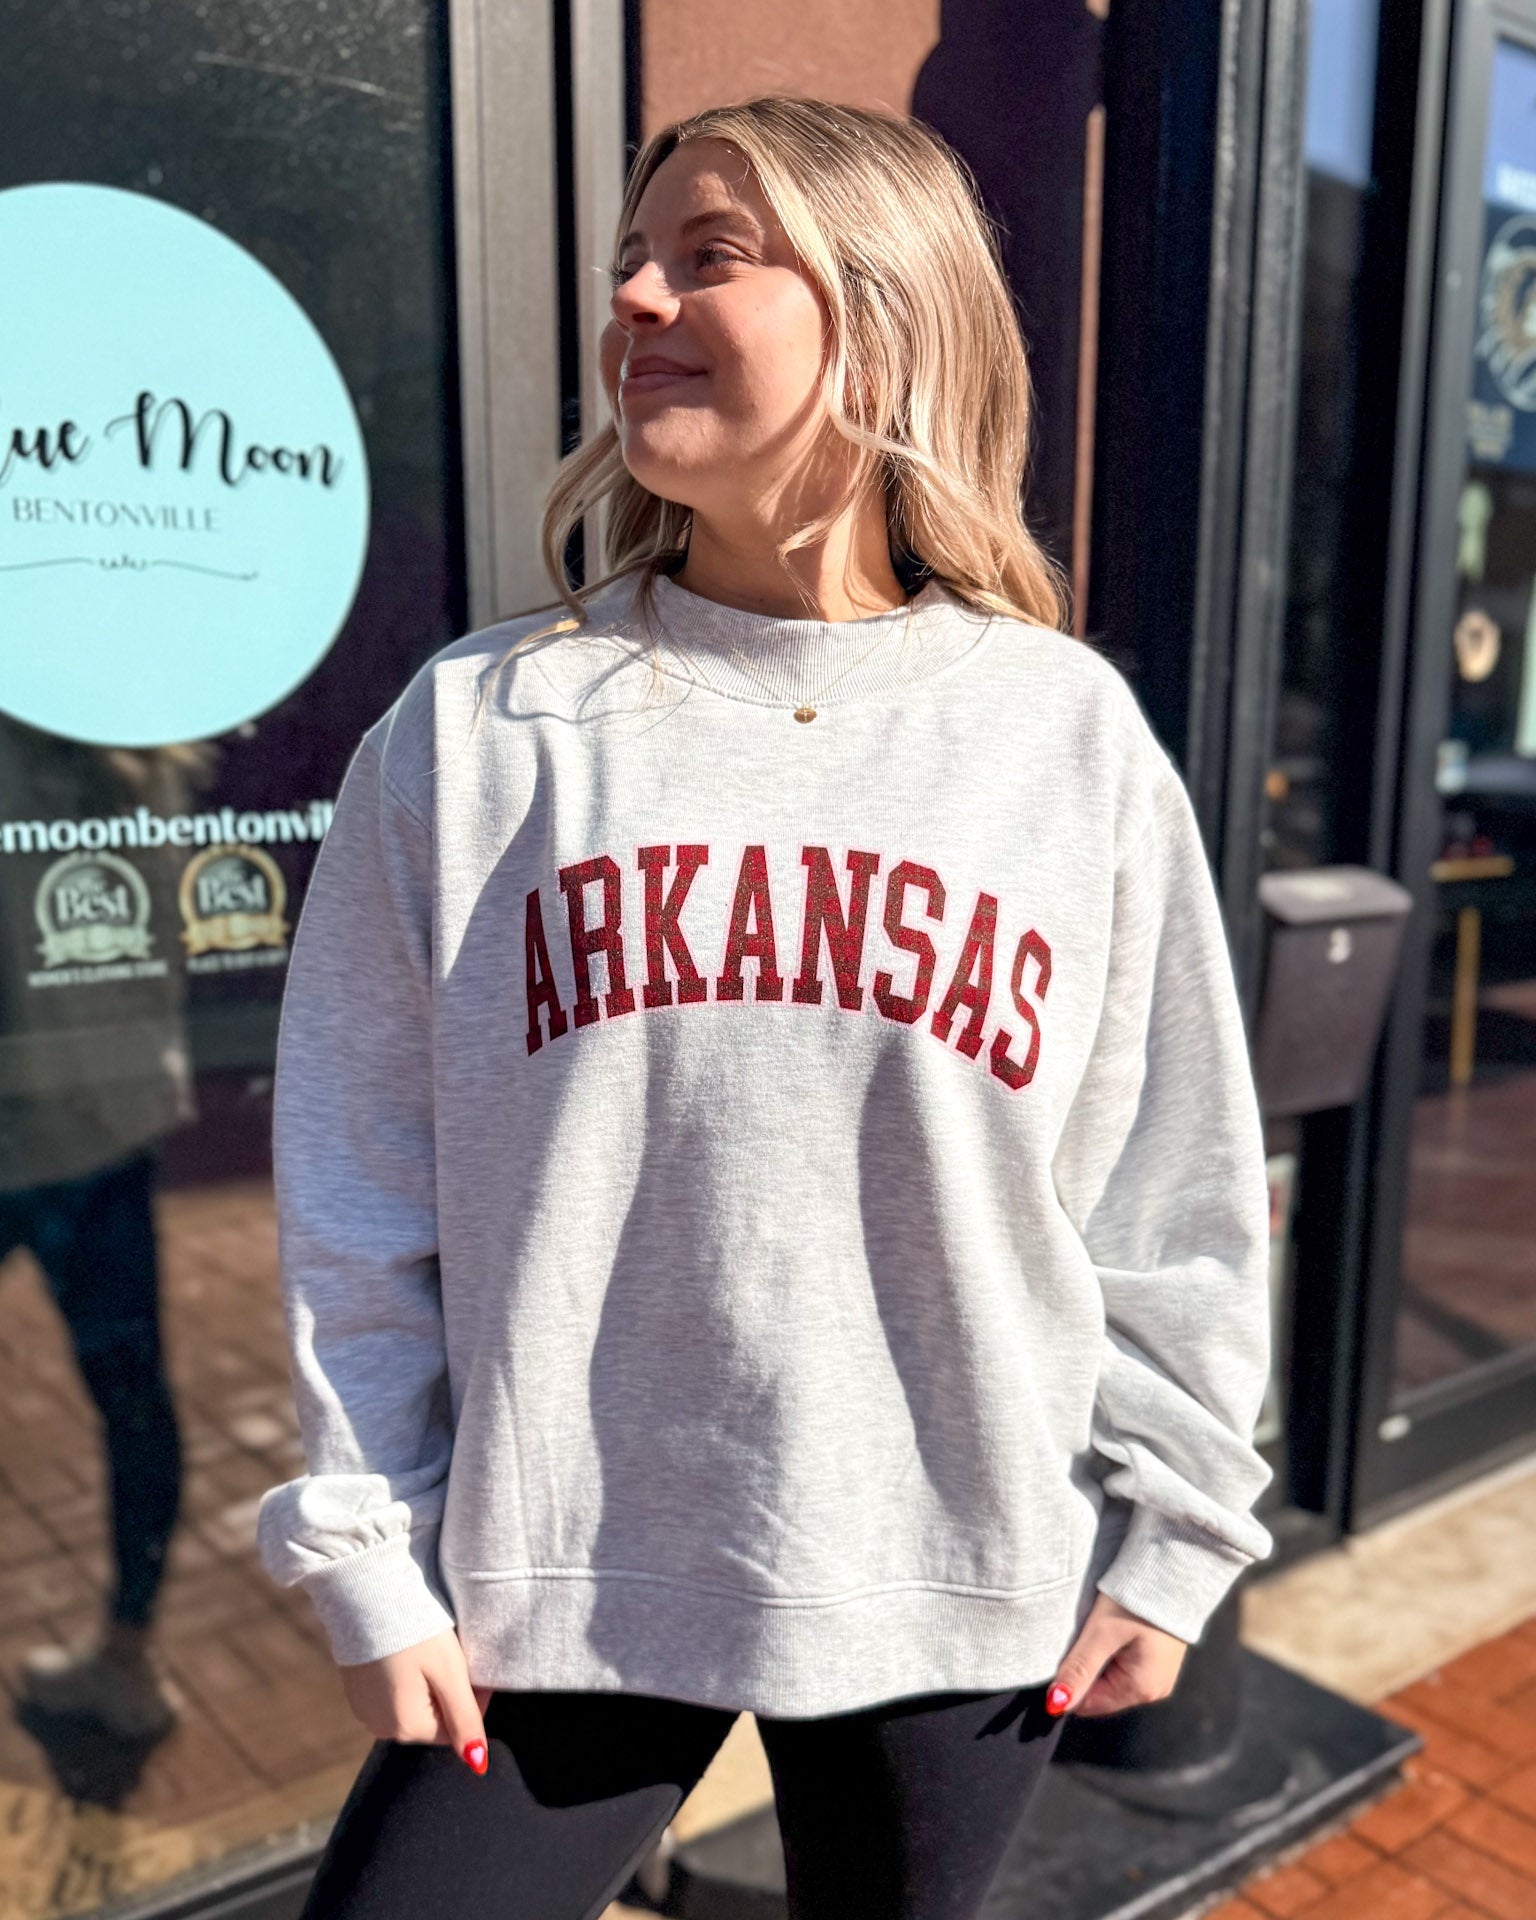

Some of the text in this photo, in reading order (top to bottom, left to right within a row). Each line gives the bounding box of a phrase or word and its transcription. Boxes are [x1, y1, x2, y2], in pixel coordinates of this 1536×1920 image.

[0, 390, 343, 487] ue Moon
[12, 497, 222, 532] BENTONVILLE
[0, 801, 335, 852] moonbentonvil
[525, 843, 1053, 1091] ARKANSAS
